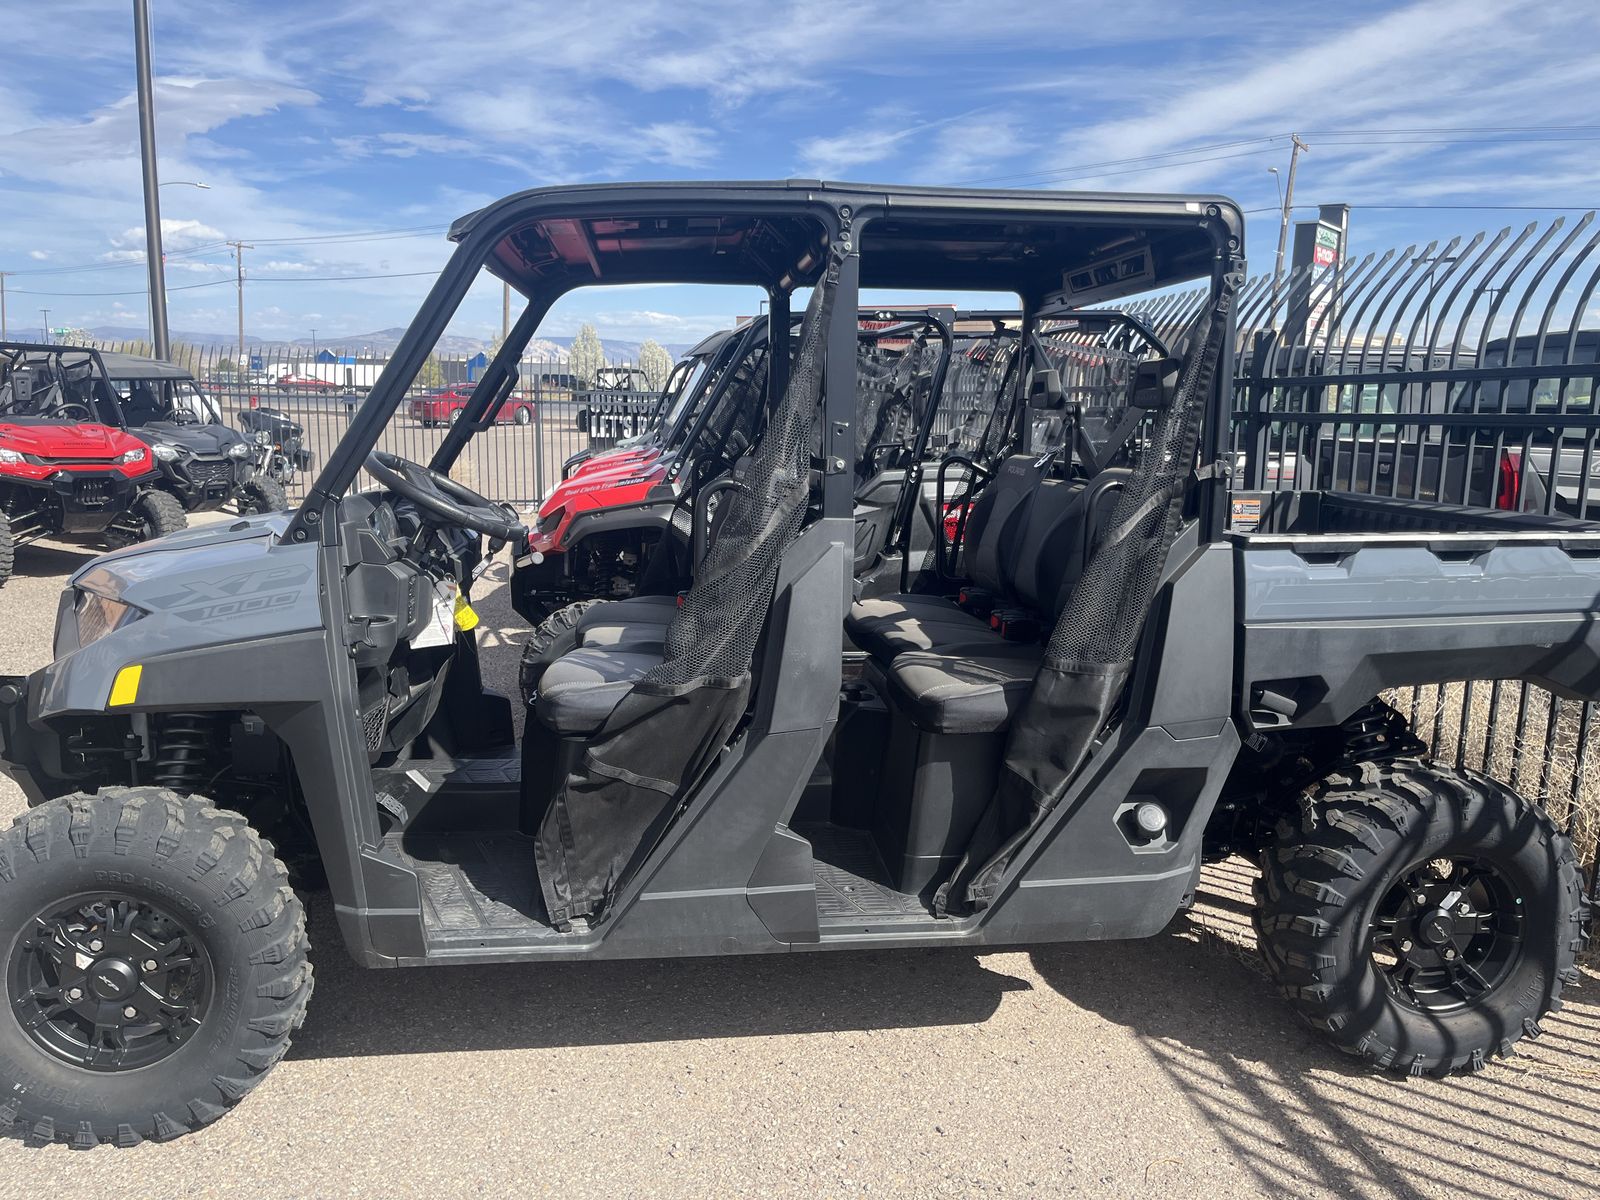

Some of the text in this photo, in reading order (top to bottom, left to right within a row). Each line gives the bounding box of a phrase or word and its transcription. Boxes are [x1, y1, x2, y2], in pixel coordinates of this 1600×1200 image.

[591, 415, 632, 439] LET'S
[564, 477, 645, 496] Dual Clutch Transmission
[168, 563, 313, 609] XP
[201, 590, 302, 619] 1000
